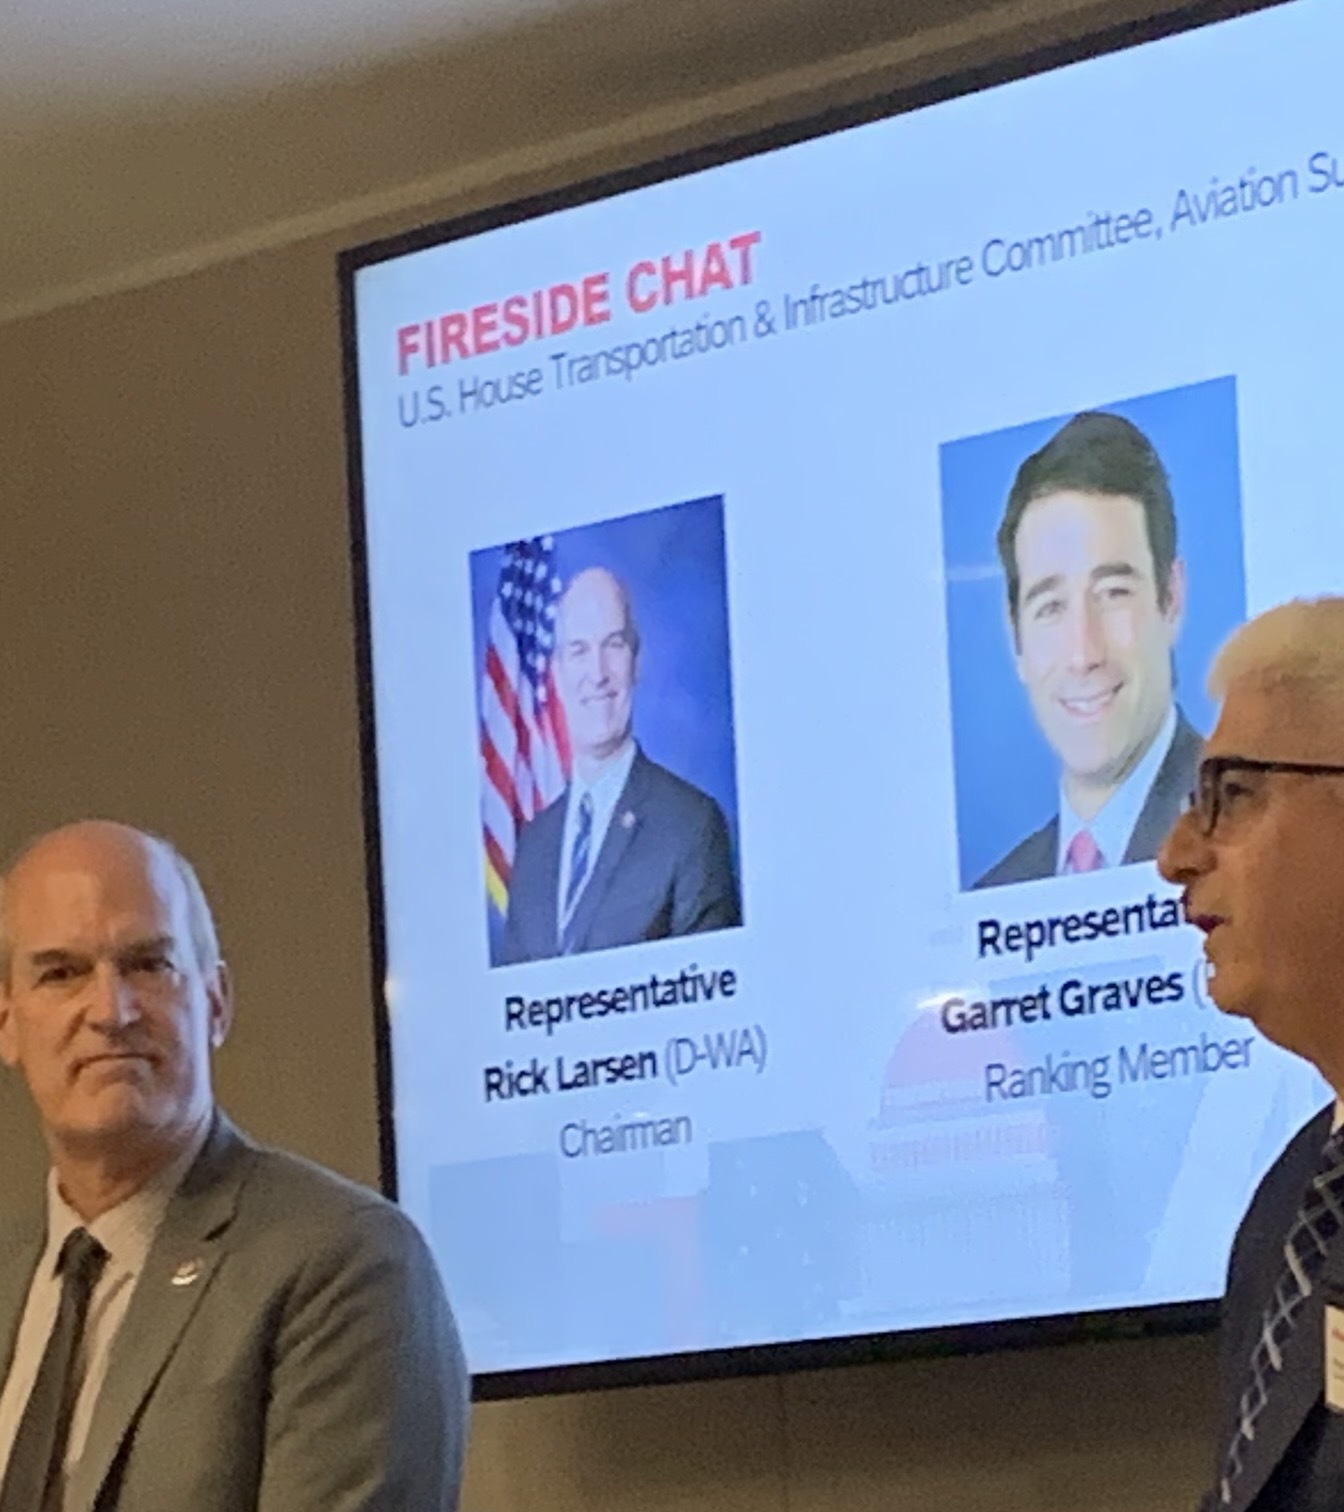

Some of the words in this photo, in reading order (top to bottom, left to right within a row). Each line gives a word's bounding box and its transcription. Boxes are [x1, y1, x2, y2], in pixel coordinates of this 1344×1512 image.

[397, 273, 610, 376] FIRESIDE
[625, 231, 761, 313] CHAT
[398, 386, 451, 428] U.S.
[459, 366, 543, 413] House
[550, 312, 746, 390] Transportation
[756, 300, 776, 338] &
[784, 254, 974, 330] Infrastructure
[982, 204, 1162, 276] Committee,
[1171, 165, 1298, 230] Aviation
[977, 894, 1180, 961] Representa
[505, 963, 737, 1035] Representative
[941, 981, 1051, 1034] Garret
[1059, 969, 1184, 1017] Graves
[483, 1057, 550, 1101] Rick
[556, 1050, 657, 1091] Larsen
[665, 1024, 767, 1086] (D-WA)
[984, 1048, 1110, 1102] Ranking
[1118, 1032, 1255, 1084] Member
[560, 1113, 693, 1158] Chairman
